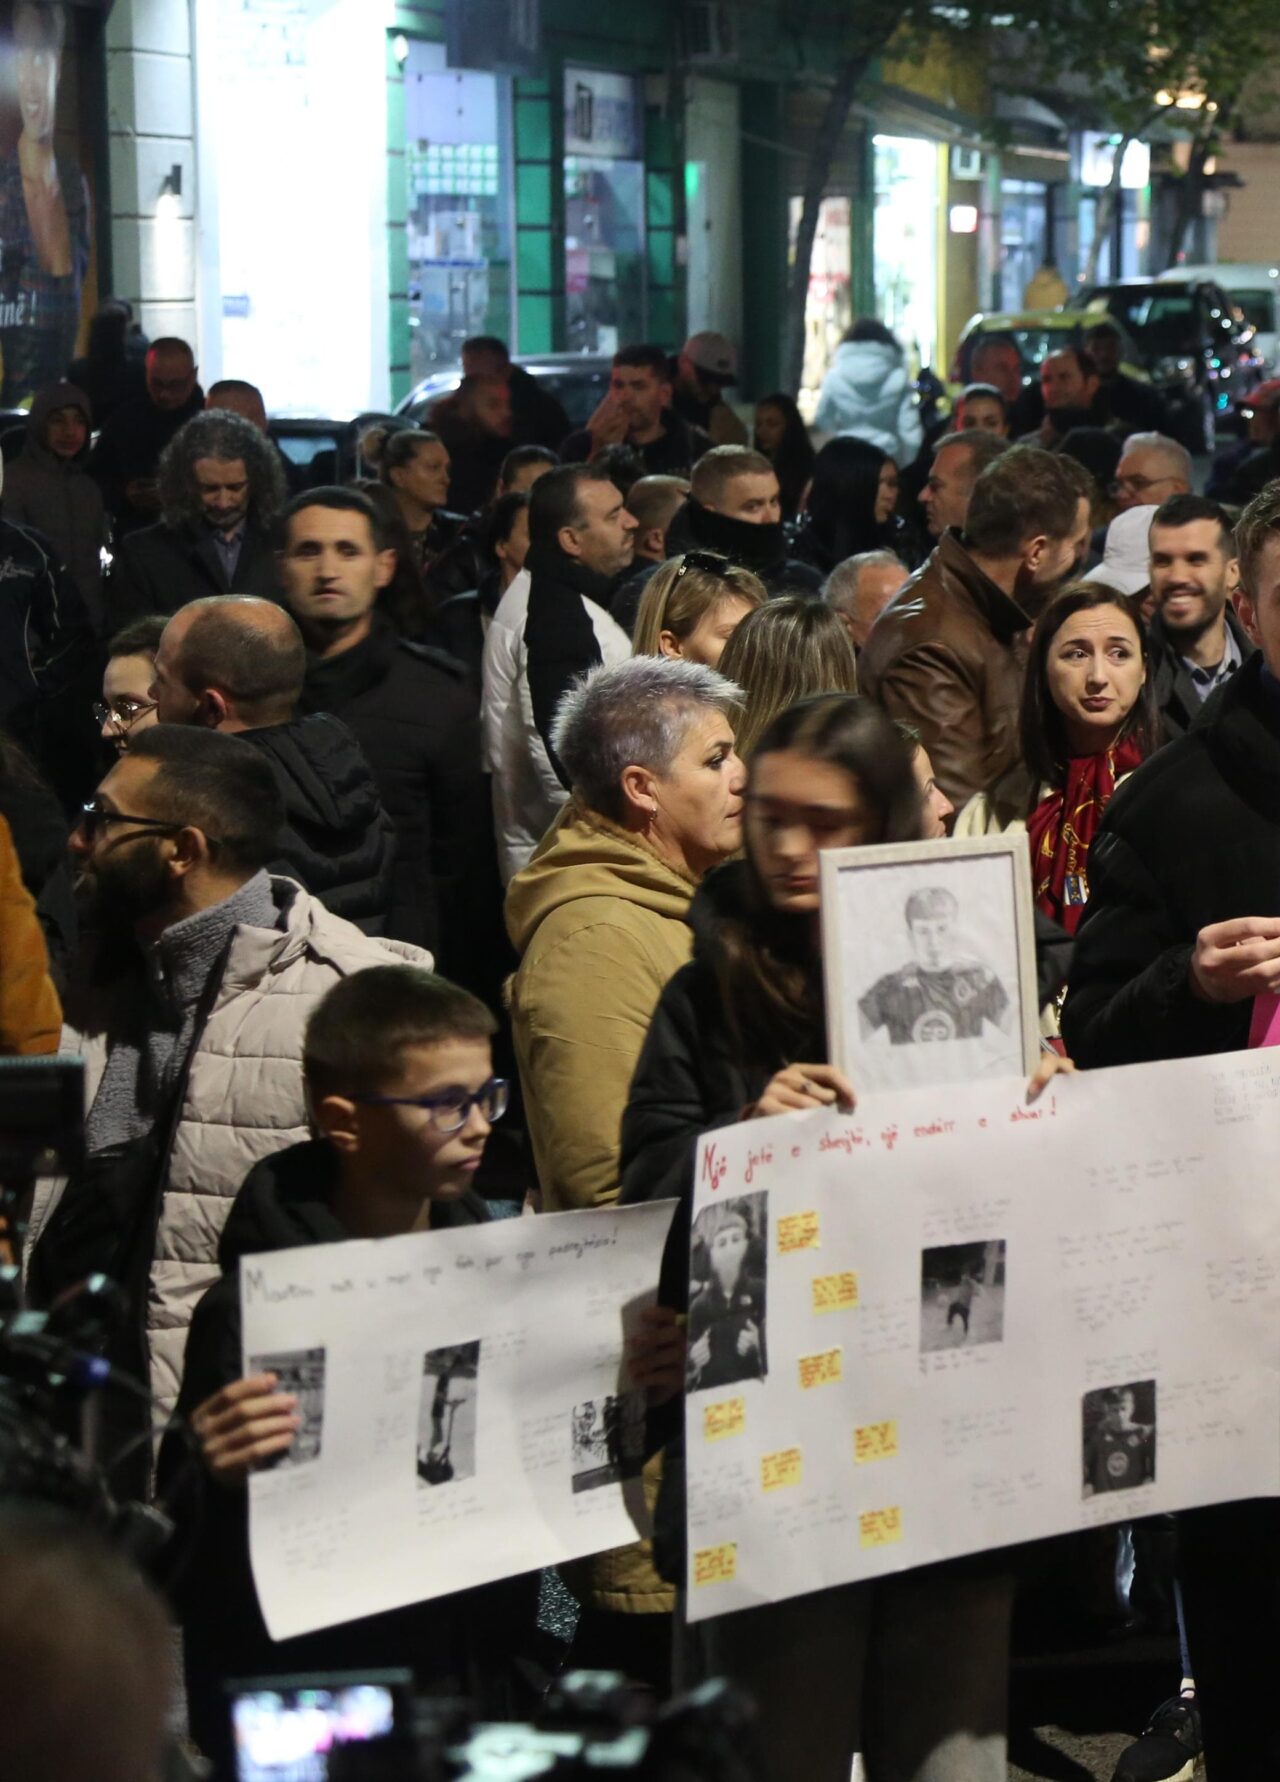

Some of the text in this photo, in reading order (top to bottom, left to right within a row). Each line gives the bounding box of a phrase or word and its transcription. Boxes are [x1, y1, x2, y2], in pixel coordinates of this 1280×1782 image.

[702, 1144, 727, 1190] Një
[744, 1143, 773, 1182] jetë
[791, 1146, 801, 1158] e
[977, 1117, 988, 1128] e
